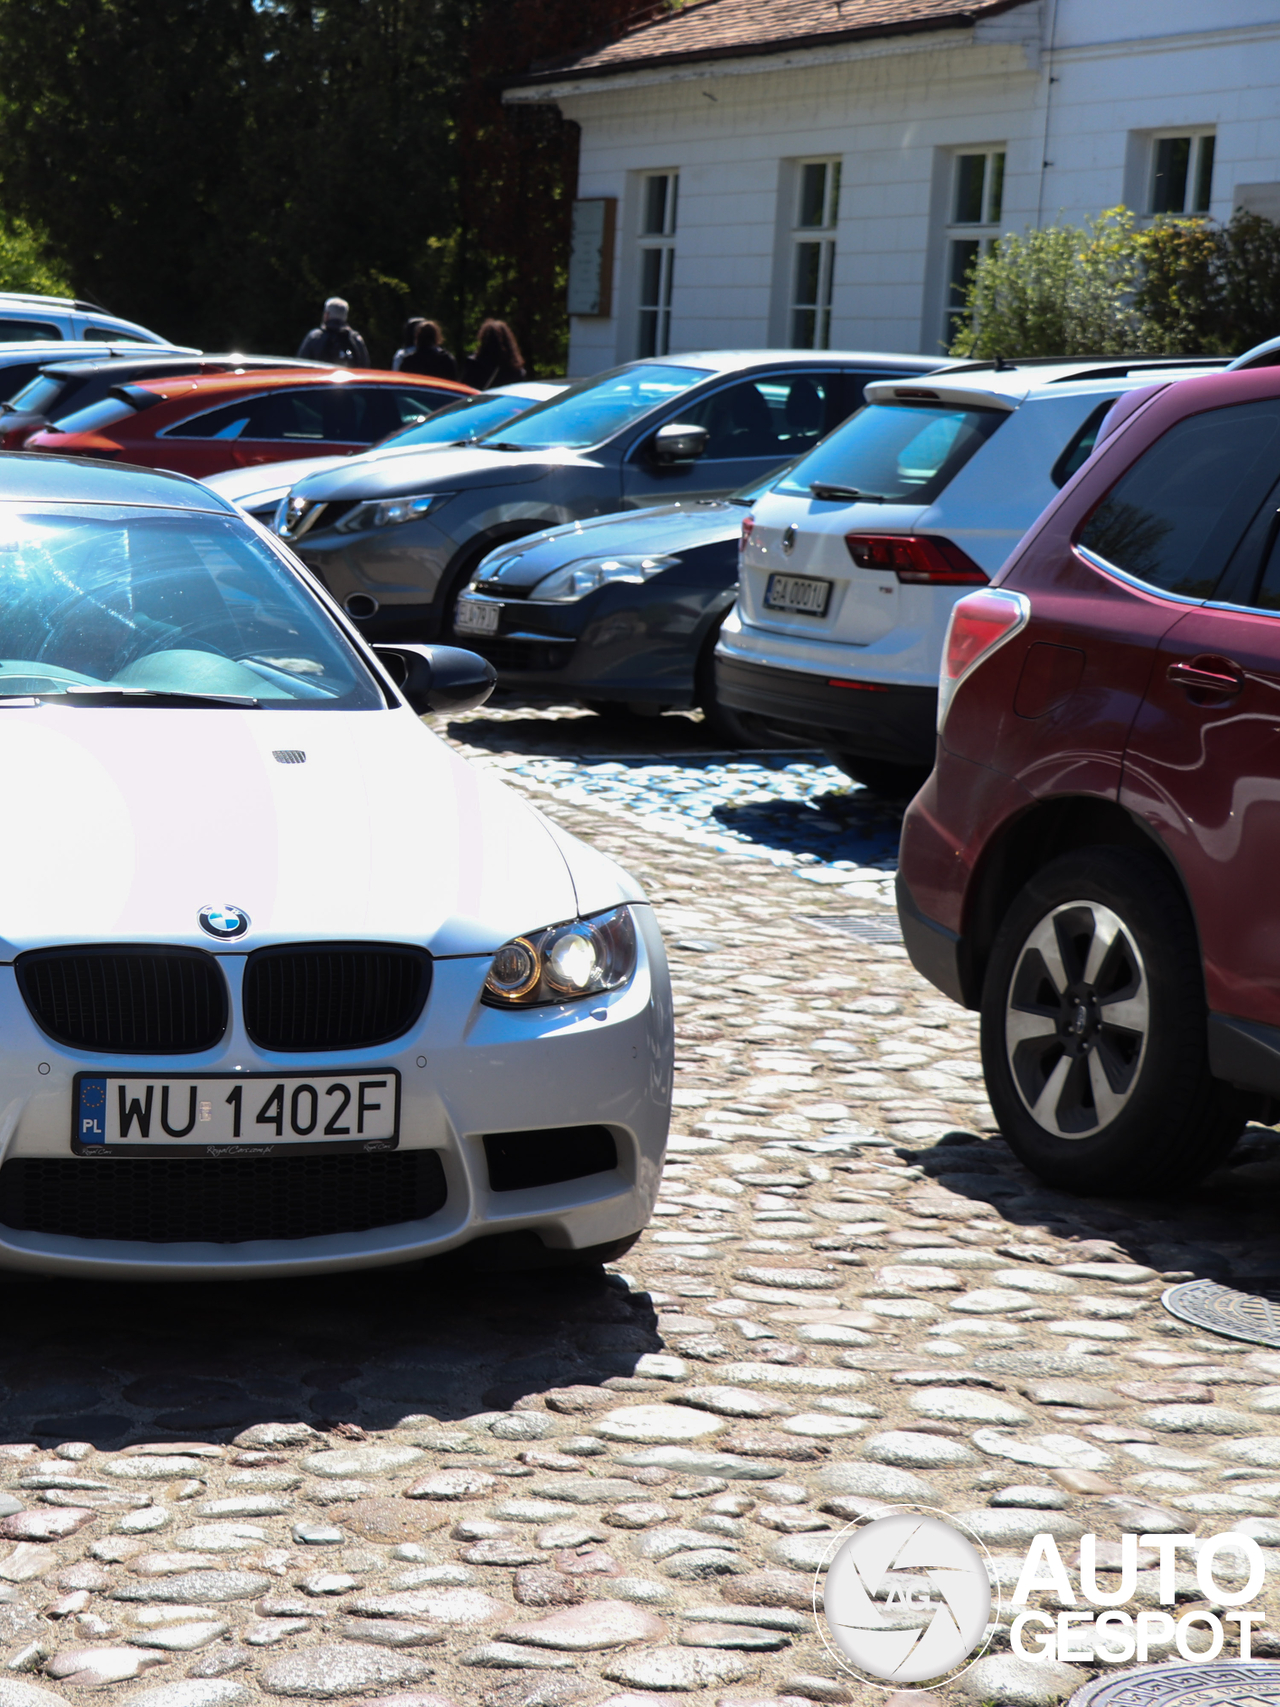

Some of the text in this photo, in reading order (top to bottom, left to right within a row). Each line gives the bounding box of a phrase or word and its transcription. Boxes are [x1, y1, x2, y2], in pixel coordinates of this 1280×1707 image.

[82, 1119, 102, 1134] PL
[118, 1080, 387, 1138] WU 1402F
